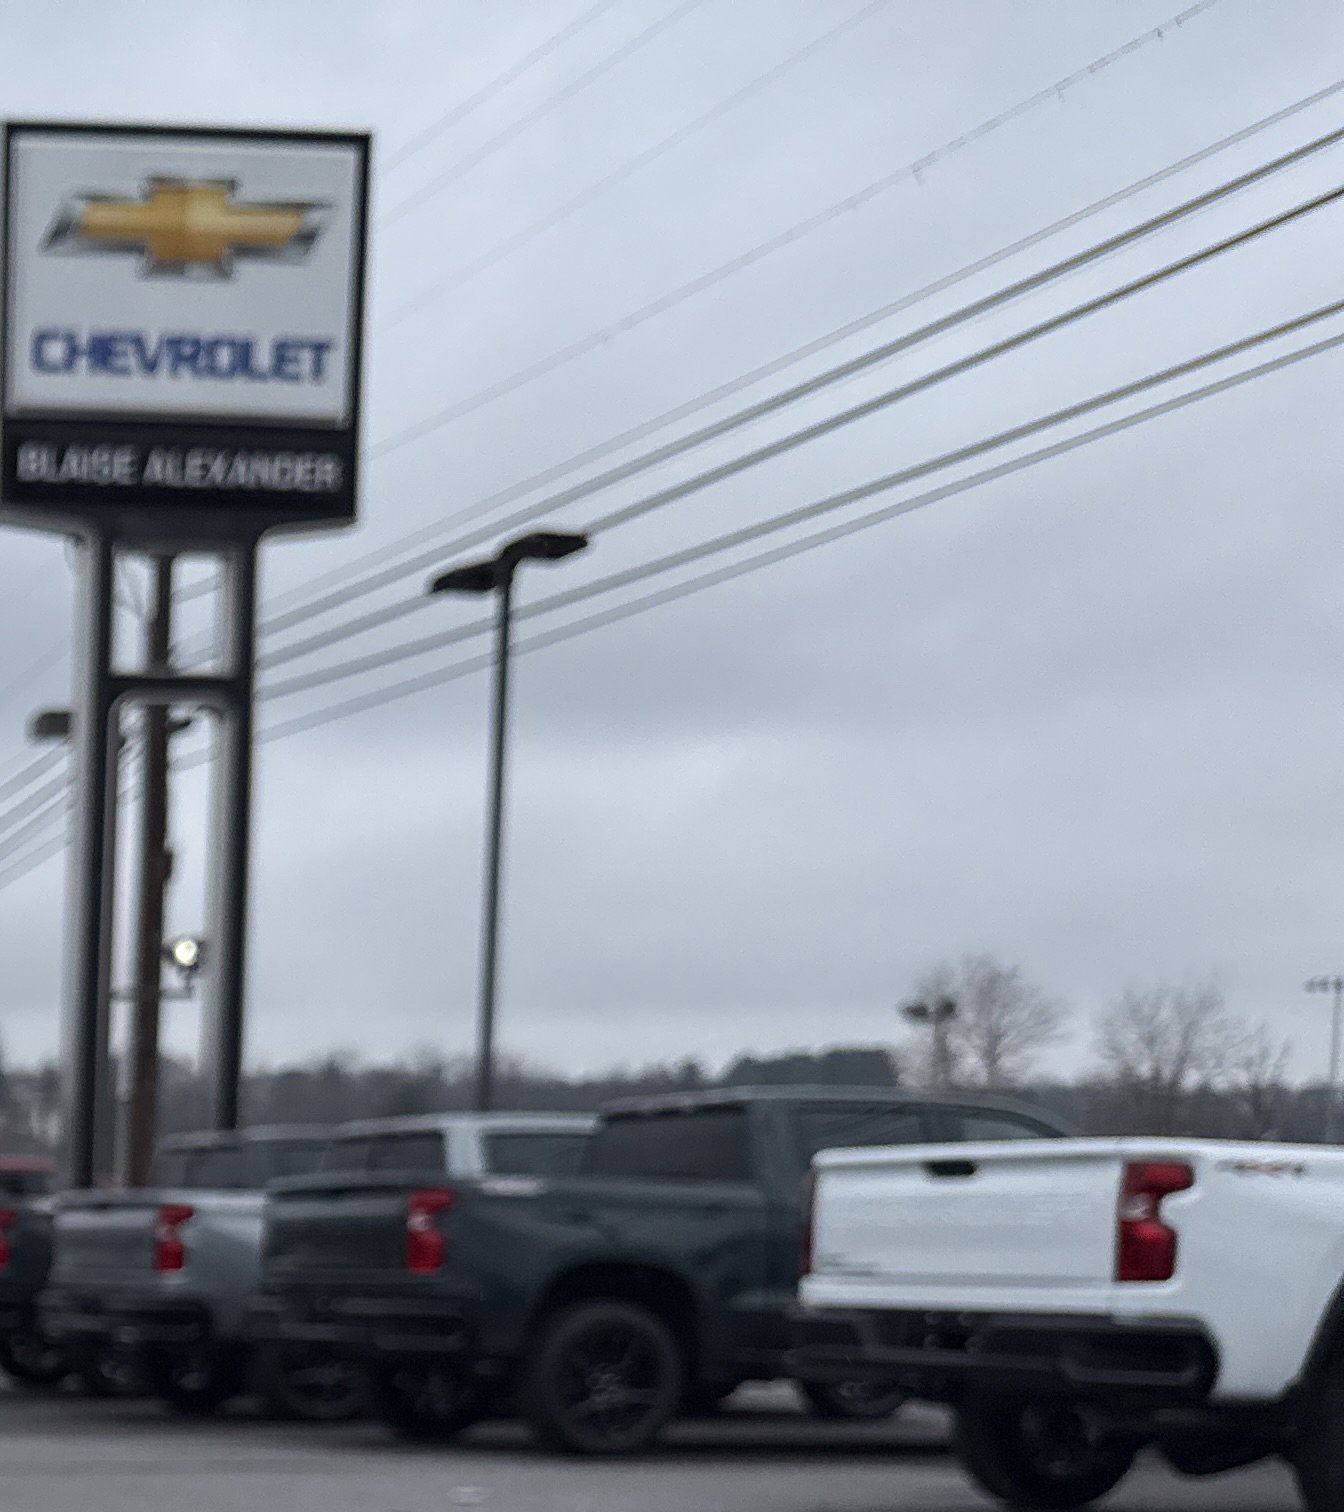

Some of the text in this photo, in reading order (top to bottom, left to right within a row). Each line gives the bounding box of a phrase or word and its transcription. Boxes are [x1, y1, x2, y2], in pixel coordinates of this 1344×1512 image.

[31, 330, 333, 382] CHEVROLET
[16, 442, 341, 492] BLAISE ALEXANDER
